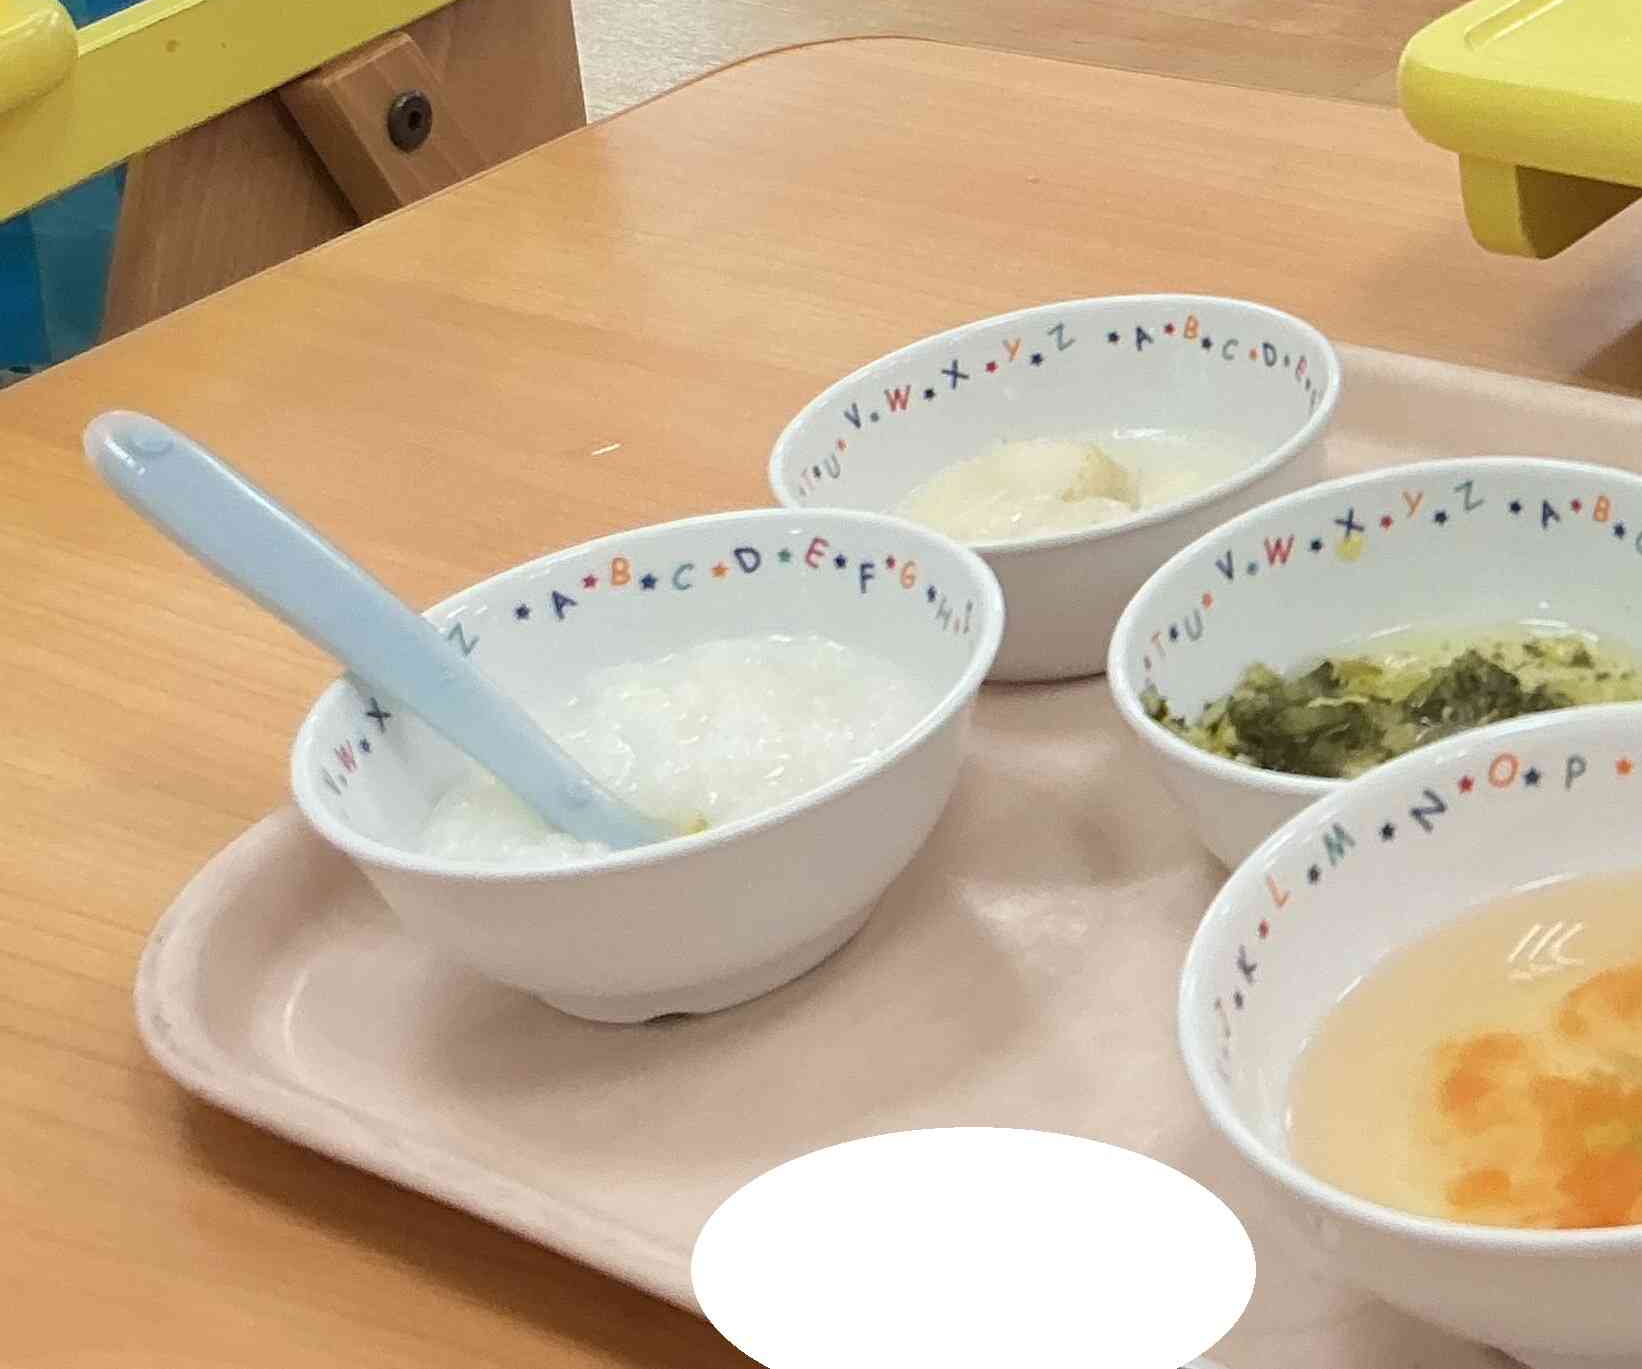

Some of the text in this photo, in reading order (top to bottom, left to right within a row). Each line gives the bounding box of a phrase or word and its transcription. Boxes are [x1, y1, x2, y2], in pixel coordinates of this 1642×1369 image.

[824, 453, 840, 479] U
[844, 403, 861, 429] V
[884, 386, 911, 412] W
[942, 360, 969, 389] X
[1002, 338, 1021, 362] Y
[1047, 323, 1075, 351] Z
[1136, 326, 1153, 351] A
[1183, 315, 1199, 340] B
[1222, 339, 1238, 360] C
[1262, 342, 1277, 367] D
[366, 697, 391, 732] X
[447, 622, 479, 657] Z
[552, 591, 577, 619] A
[610, 557, 631, 586] B
[672, 563, 694, 590] C
[734, 547, 761, 573] D
[805, 537, 829, 569] E
[860, 562, 874, 593] F
[900, 560, 916, 589] G
[1183, 609, 1203, 642] U
[1216, 550, 1234, 580] V
[1264, 535, 1294, 565] W
[1334, 509, 1364, 540] X
[1402, 491, 1424, 518] Y
[1454, 480, 1484, 511] Z
[1542, 500, 1560, 528] A
[1593, 496, 1610, 523] B
[1266, 876, 1290, 908] L
[1323, 823, 1355, 866] M
[1410, 790, 1448, 832] N
[1488, 753, 1520, 788] O
[1565, 755, 1587, 789] P
